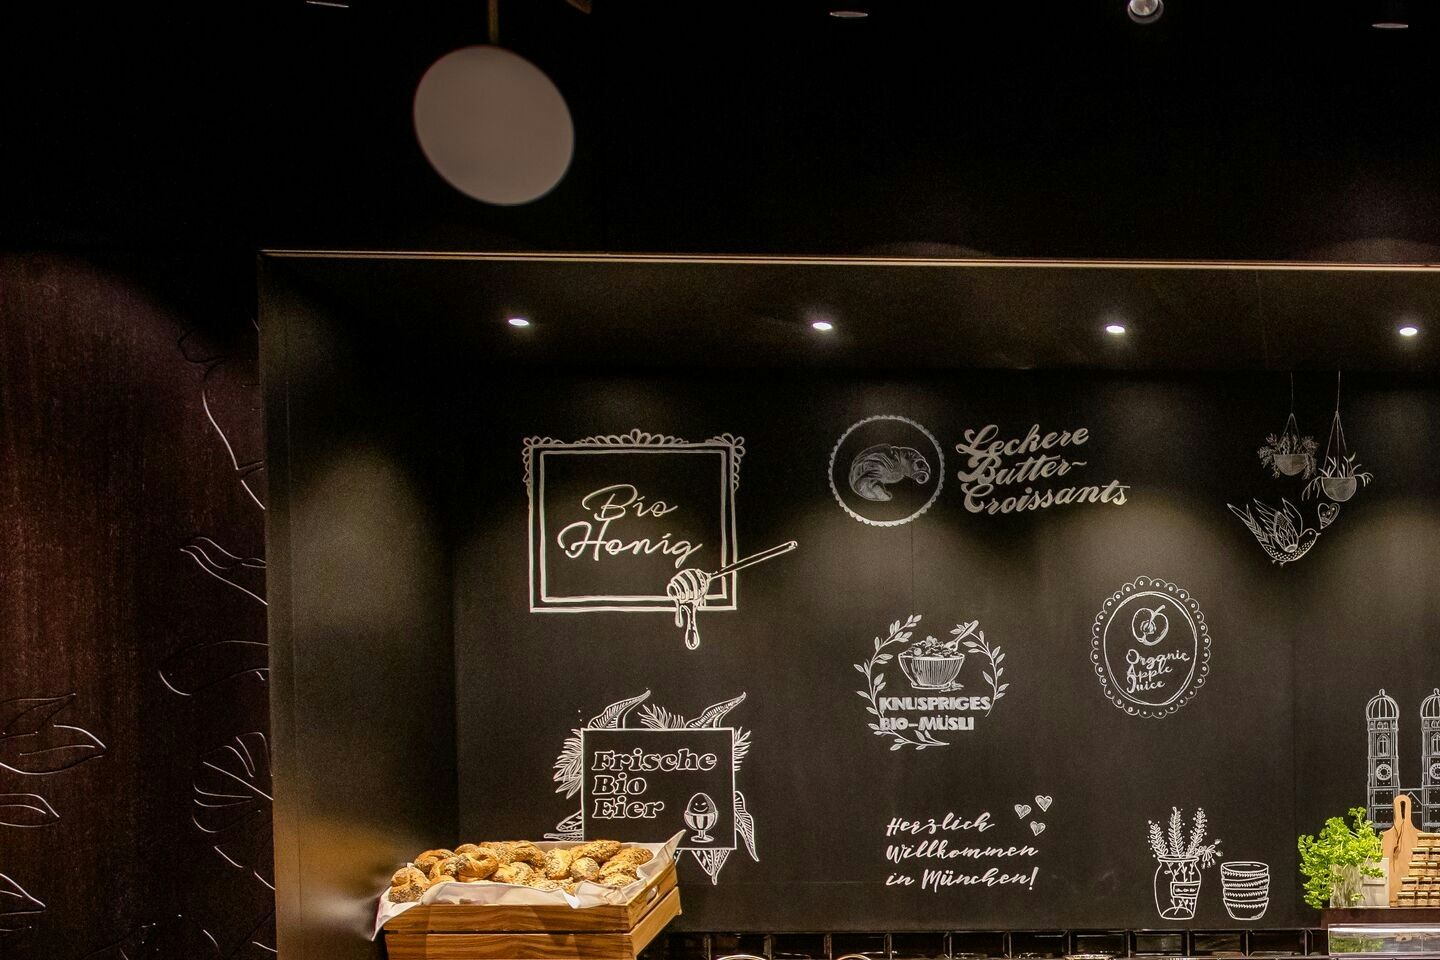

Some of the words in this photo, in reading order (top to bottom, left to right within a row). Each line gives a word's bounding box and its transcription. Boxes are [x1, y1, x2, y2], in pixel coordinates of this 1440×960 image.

[956, 424, 1089, 457] Leckere
[581, 484, 678, 521] Bio
[960, 480, 1131, 515] Croissants
[557, 519, 703, 568] Honig
[1125, 649, 1190, 669] Organic
[1127, 660, 1173, 682] Apple
[1126, 674, 1165, 693] Juice
[879, 696, 991, 710] KNUSPRIGES
[879, 715, 975, 730] BIO-MÜSLI
[591, 748, 717, 771] Frische
[591, 772, 647, 795] Bio
[591, 796, 665, 819] Eier
[886, 812, 995, 836] Herzlich
[886, 839, 1039, 864] Willkommen
[886, 873, 915, 886] in
[921, 866, 1039, 893] München!
